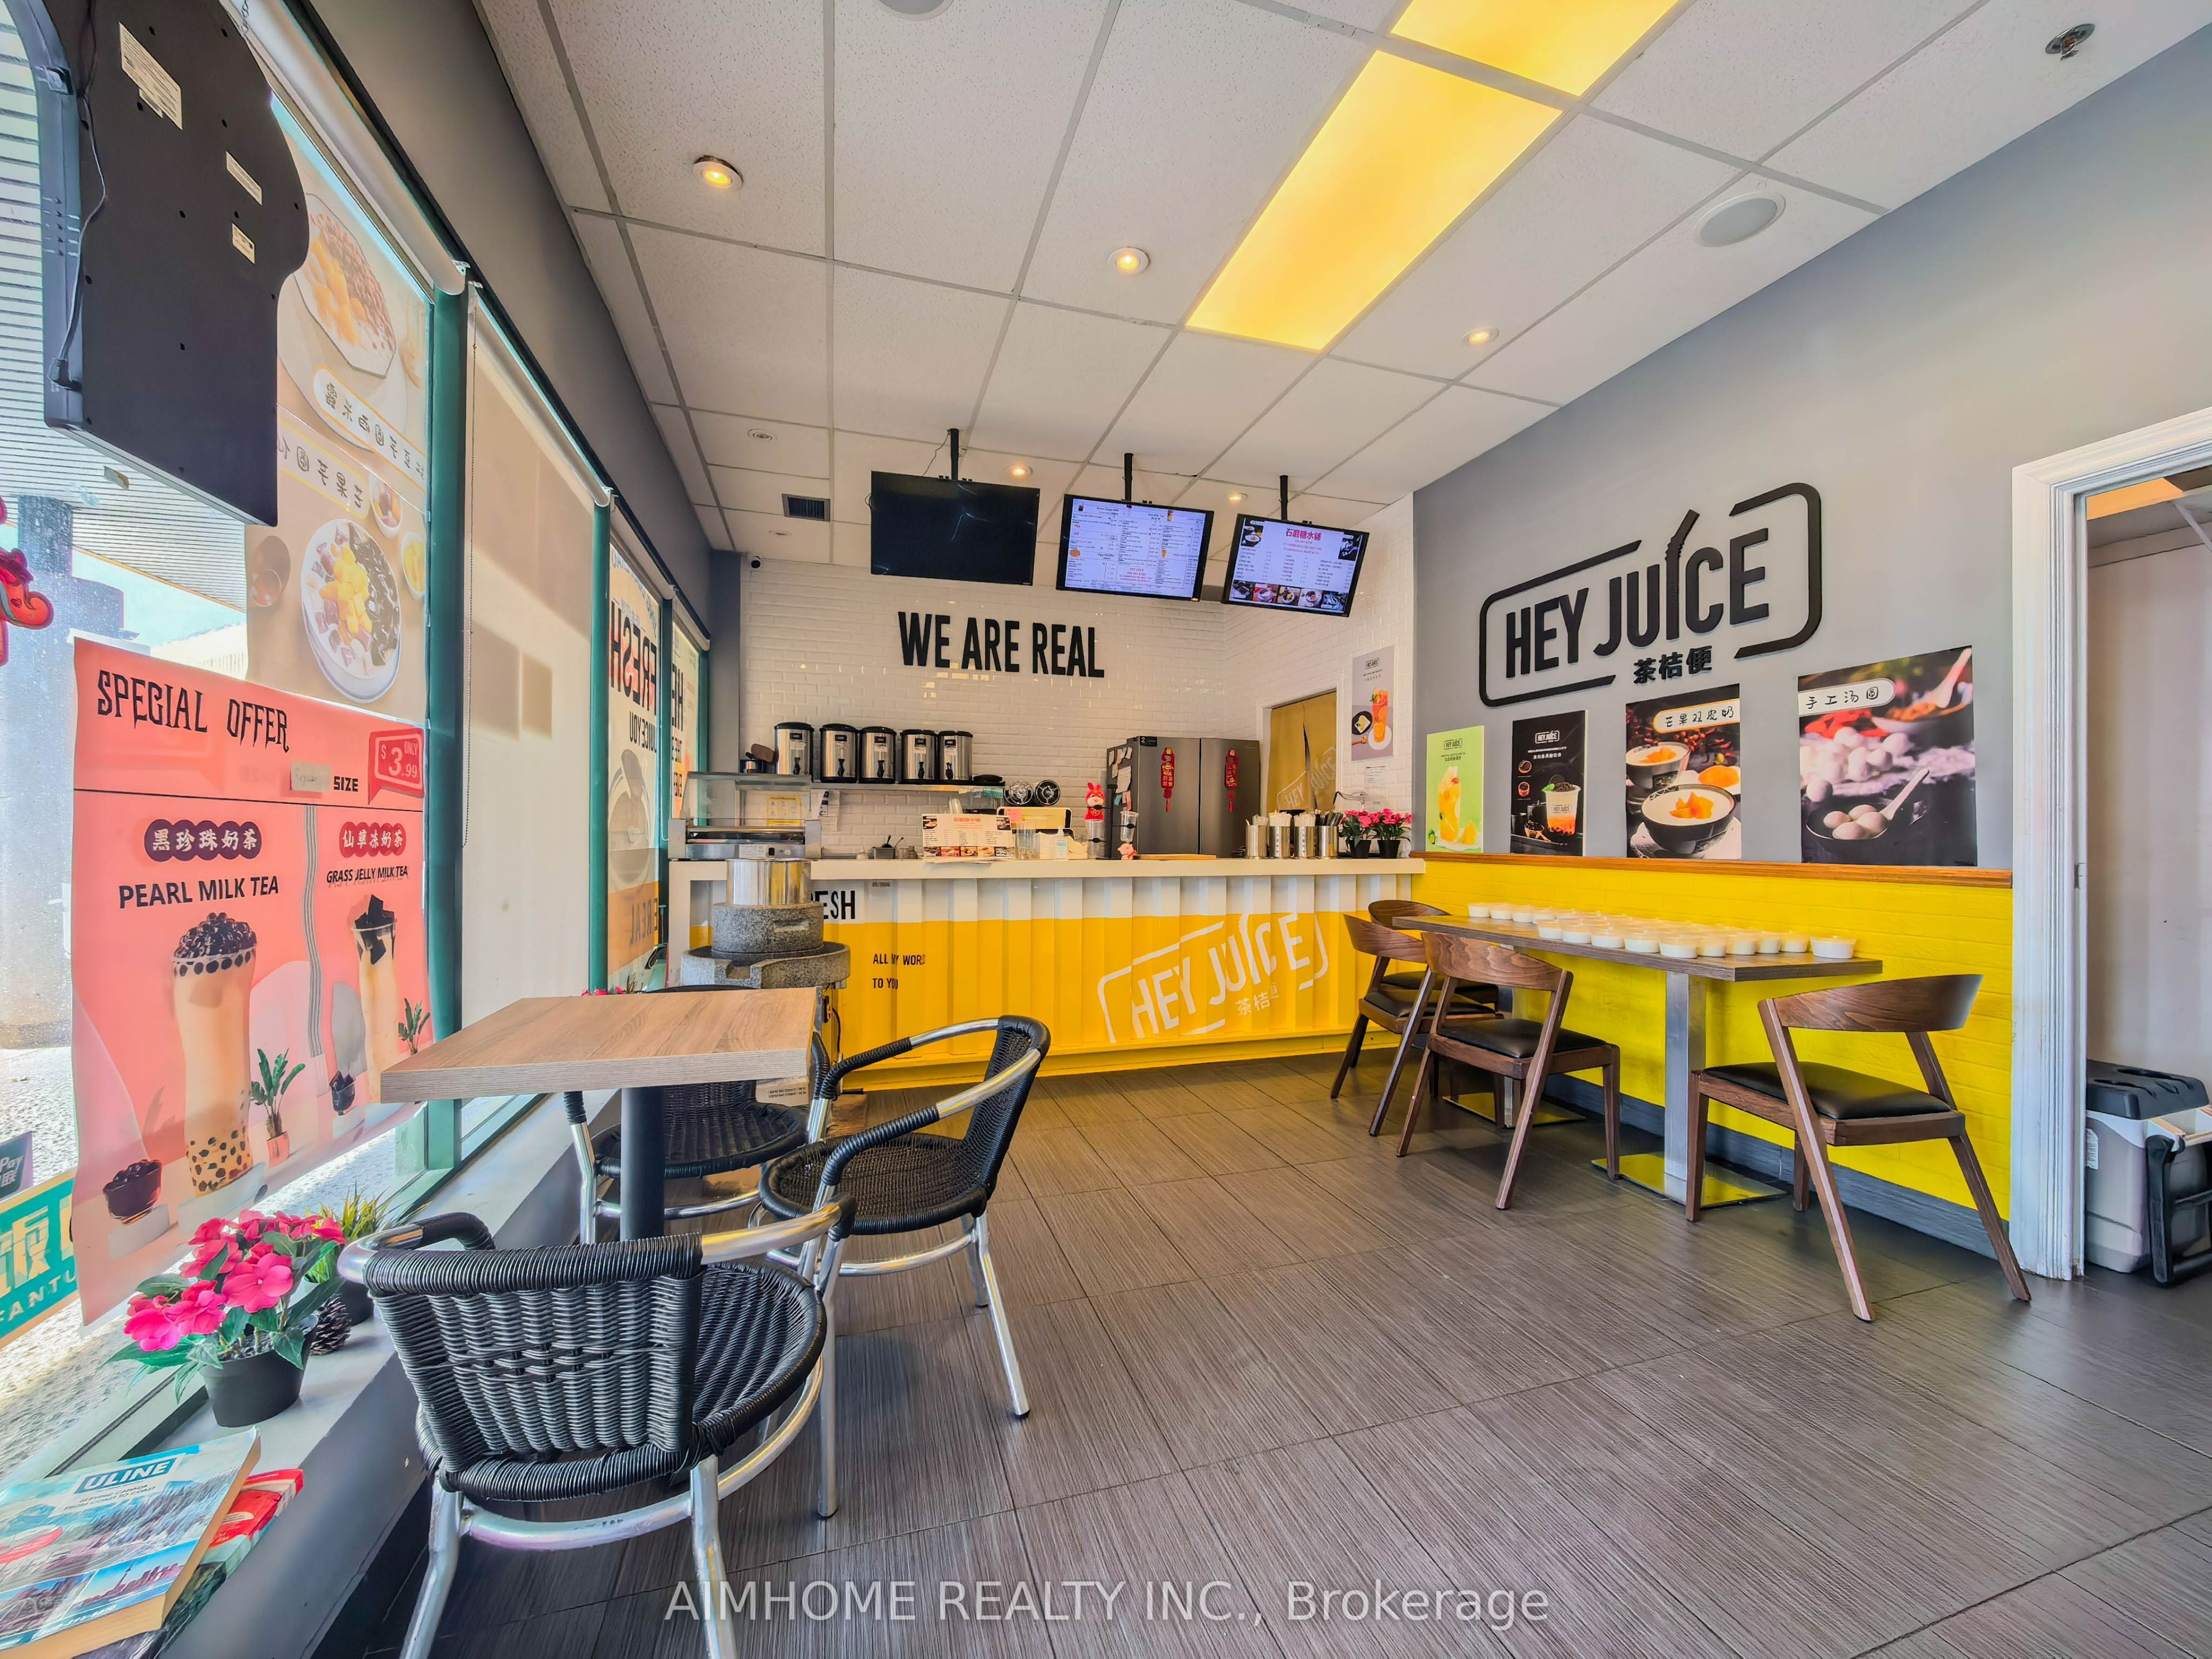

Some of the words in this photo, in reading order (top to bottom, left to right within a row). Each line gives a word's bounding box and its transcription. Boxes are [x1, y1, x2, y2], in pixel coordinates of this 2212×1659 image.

[1506, 588, 1589, 679] HEY
[1593, 509, 1770, 656] JUICE
[898, 612, 950, 668] WE
[961, 617, 1020, 672] ARE
[1033, 622, 1104, 678] REAL
[1633, 646, 1713, 685] 茶桔便
[98, 669, 208, 733] SPECIAL
[226, 699, 289, 753] OFFER
[1805, 686, 1878, 709] 手工汤圆
[1665, 706, 1733, 728] 芒果双皮奶
[334, 776, 358, 792] SIZE
[152, 828, 257, 853] 黑珍珠奶茶
[327, 869, 353, 883] GRASS
[355, 867, 376, 882] JELLY
[378, 866, 394, 879] MILK
[396, 865, 408, 877] TEA
[119, 881, 193, 909] PEARL
[199, 877, 246, 901] MILK
[250, 876, 279, 896] TEA
[810, 890, 855, 920] ESH
[873, 953, 888, 964] ALL
[873, 978, 884, 988] TO
[887, 978, 899, 990] YOU
[1132, 957, 1196, 1039] HEY
[1209, 913, 1310, 1006] JUICE
[85, 1461, 171, 1490] ULINE
